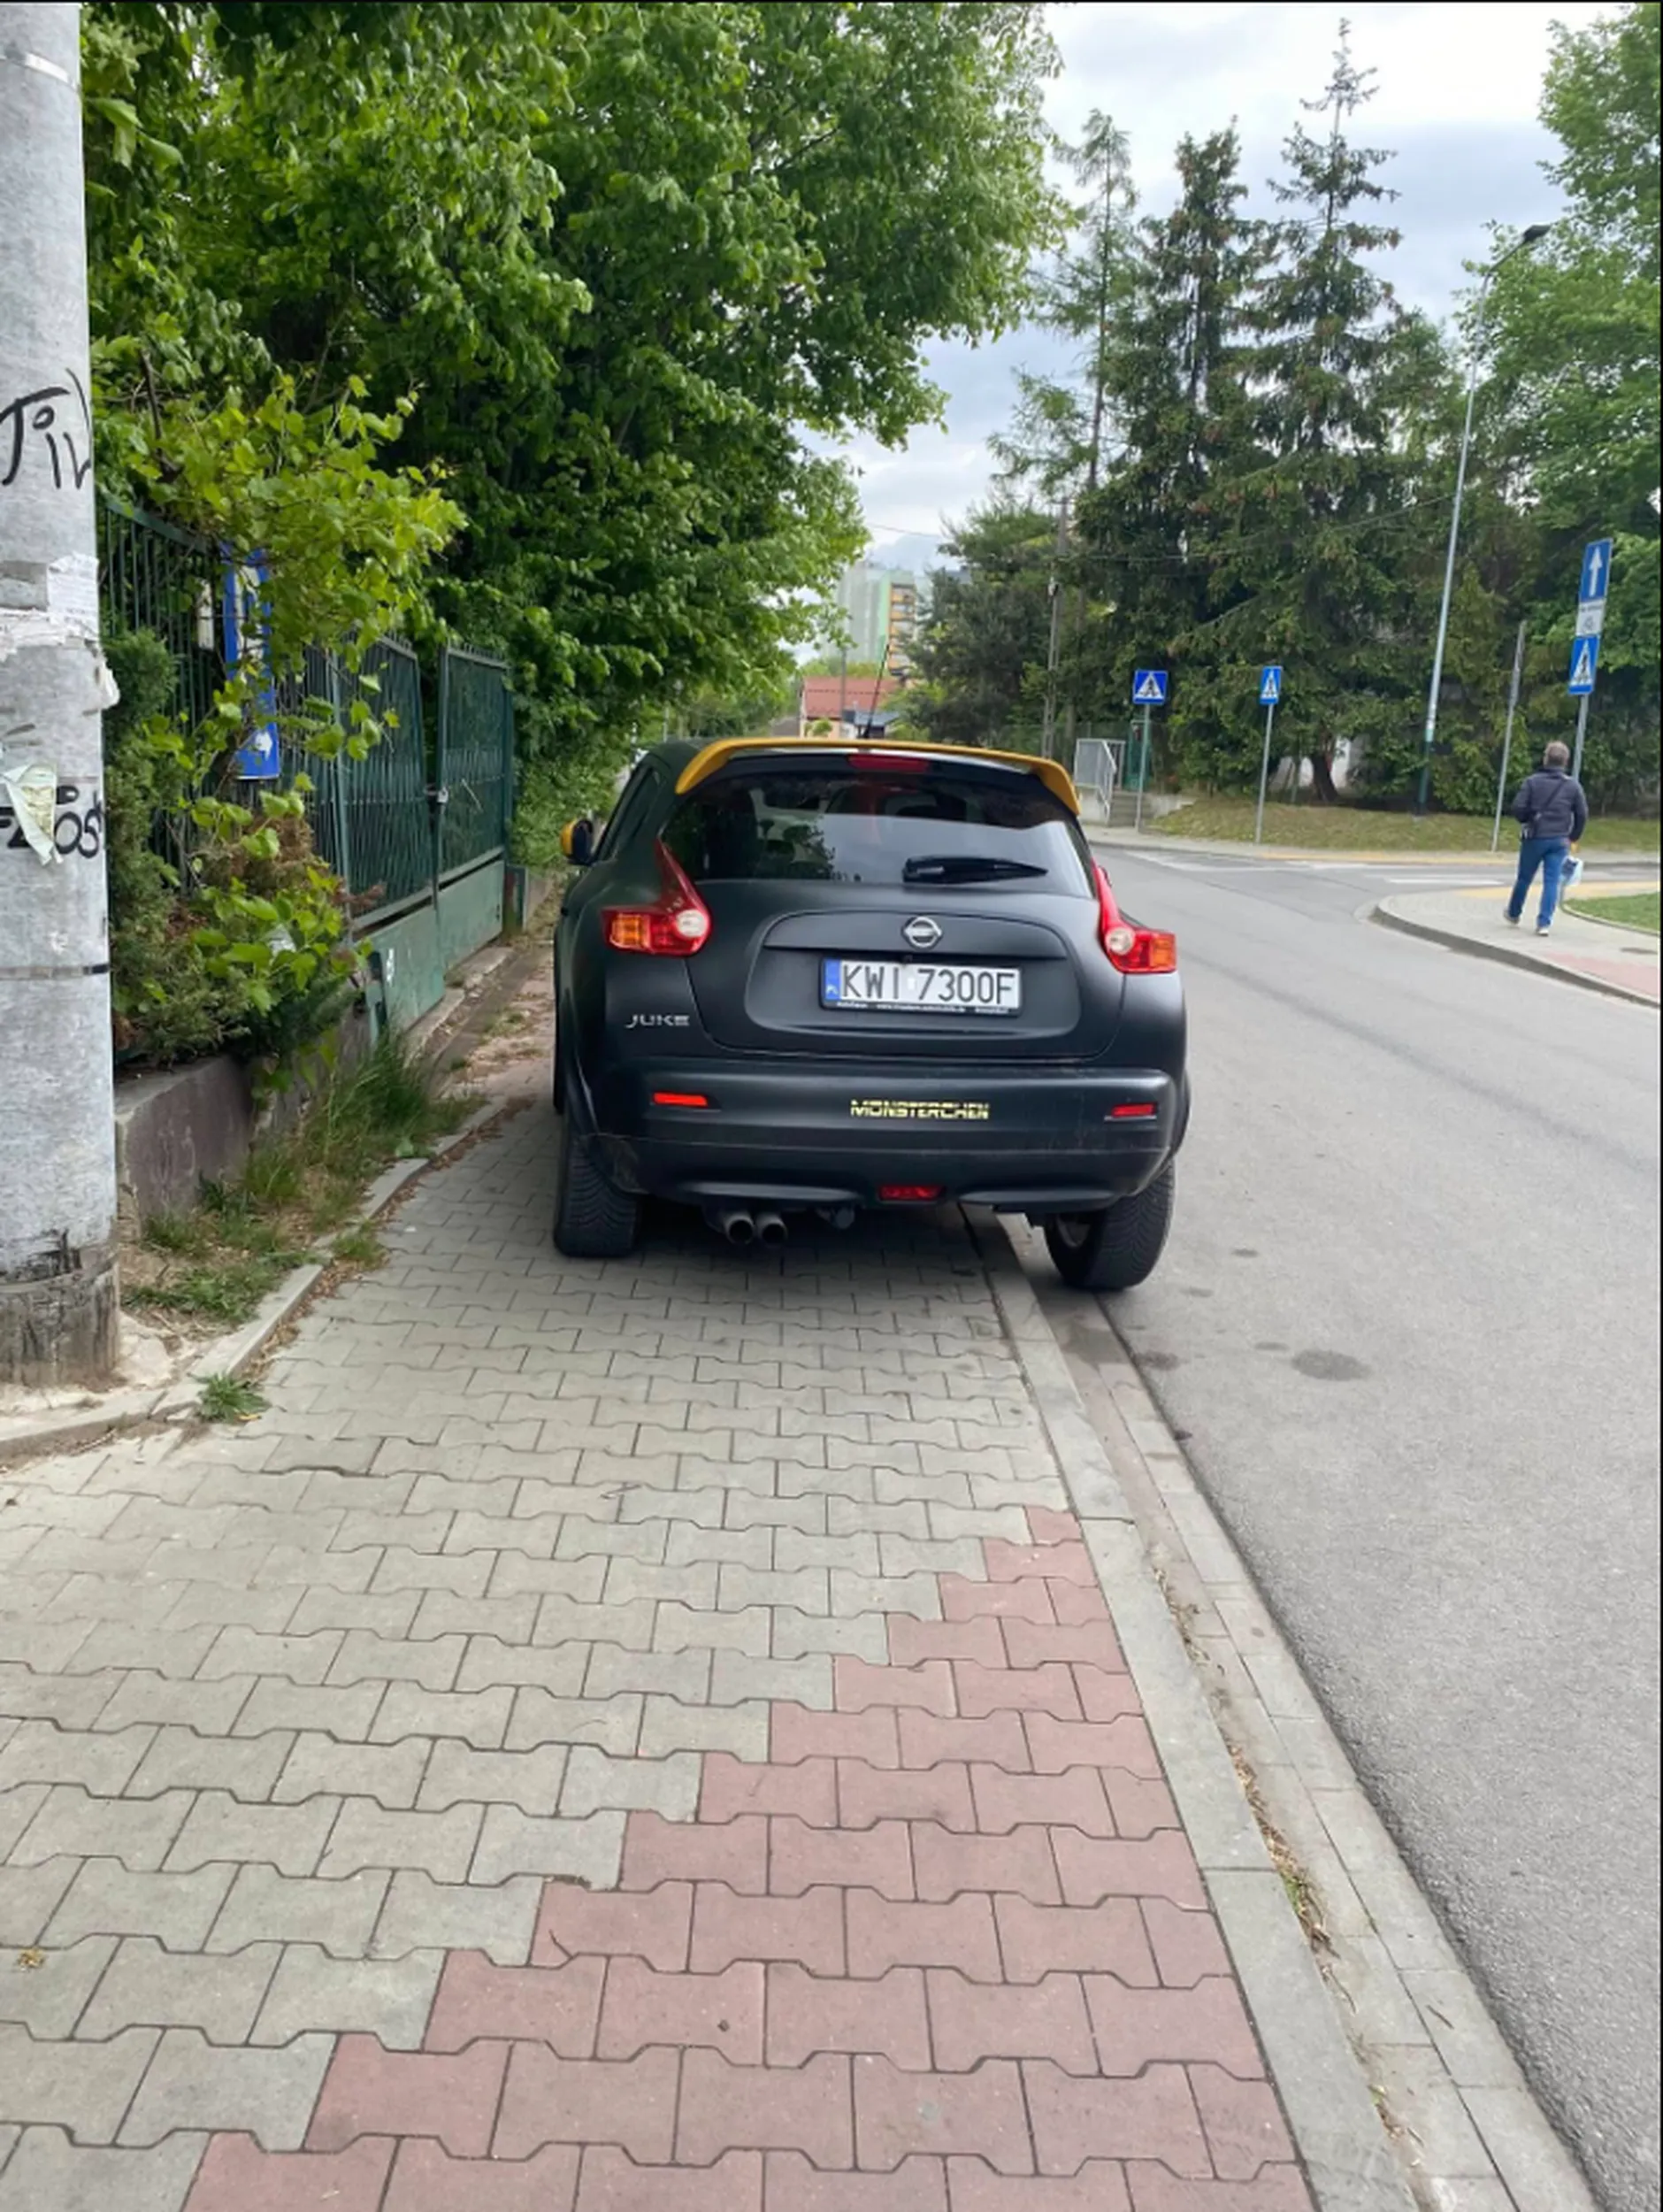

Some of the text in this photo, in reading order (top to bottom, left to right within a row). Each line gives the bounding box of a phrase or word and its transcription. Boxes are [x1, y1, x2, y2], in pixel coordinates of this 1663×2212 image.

[842, 964, 1015, 1005] KWI 7300F
[625, 1014, 690, 1029] JUKE
[850, 1099, 990, 1120] MONSTERCHEN
